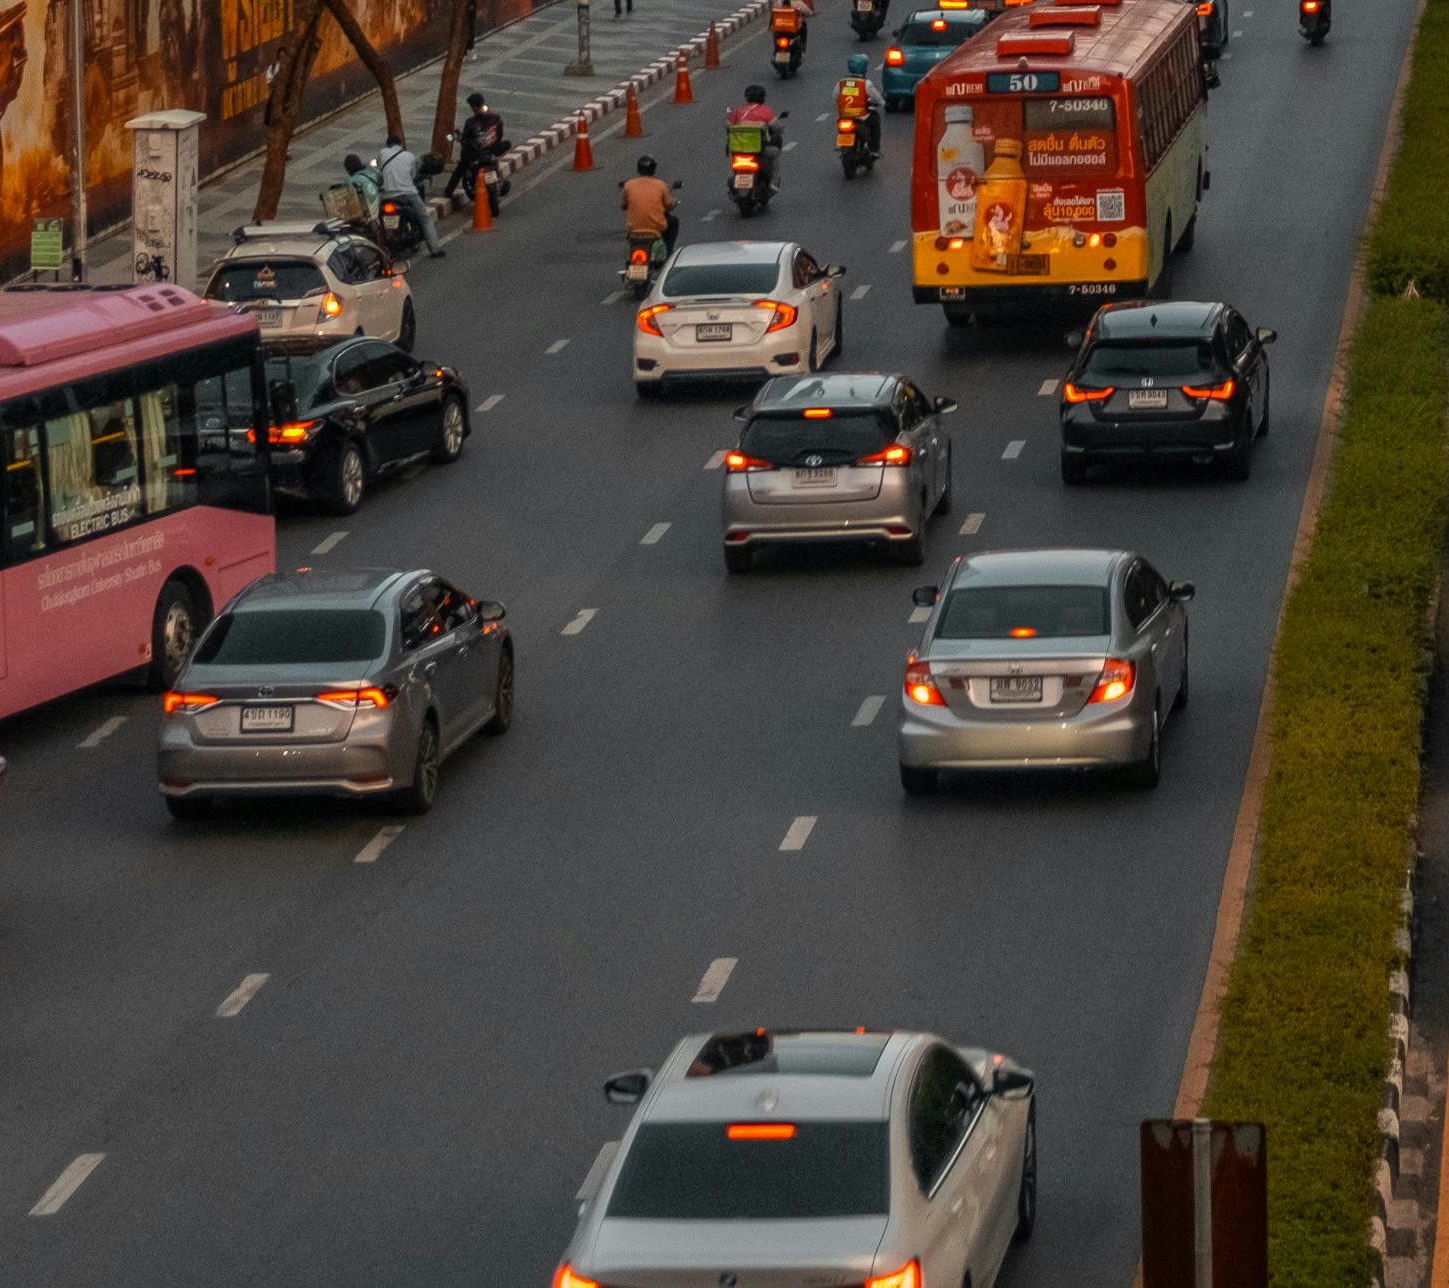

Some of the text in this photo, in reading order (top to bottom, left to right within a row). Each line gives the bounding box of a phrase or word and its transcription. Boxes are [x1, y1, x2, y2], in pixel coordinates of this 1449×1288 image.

[1009, 74, 1038, 92] 50
[1049, 99, 1108, 112] 7-50346
[1027, 133, 1105, 151] สดชื่น ตื่นตัว
[1029, 151, 1106, 167] ไม่มีแอลกอฮอล์
[1069, 285, 1116, 295] 7-50346
[70, 508, 129, 539] ELECTRIC BUS
